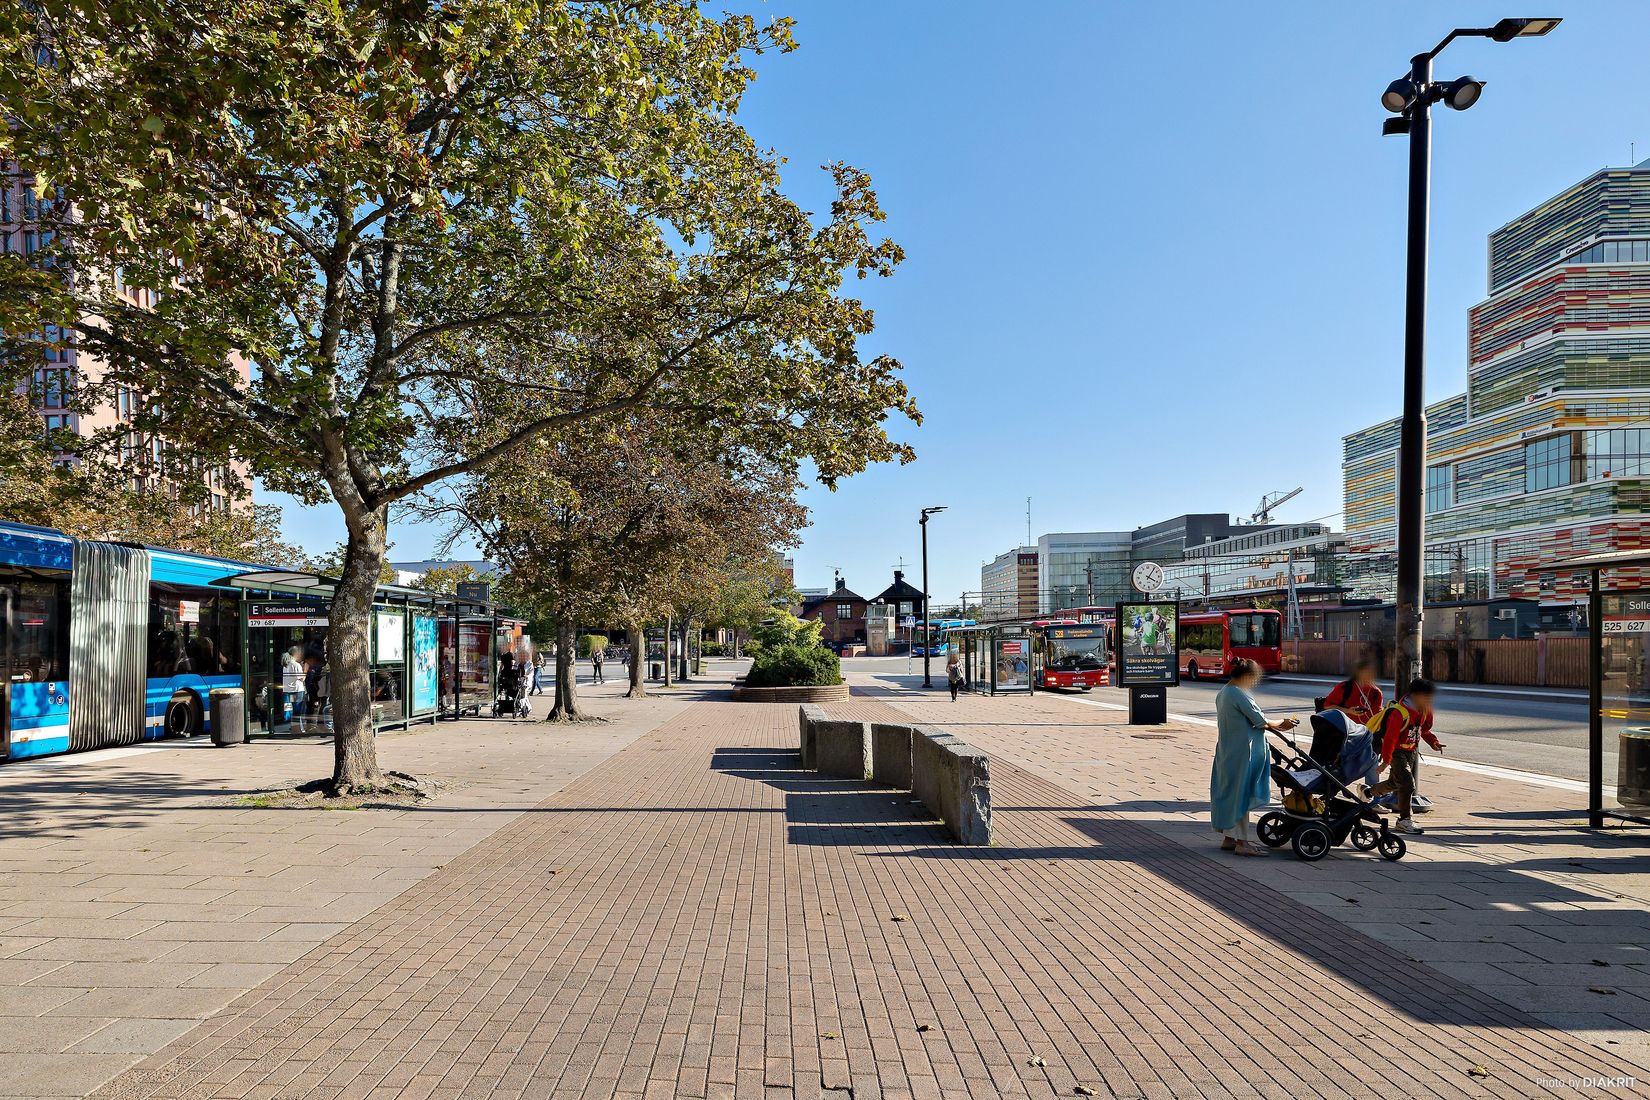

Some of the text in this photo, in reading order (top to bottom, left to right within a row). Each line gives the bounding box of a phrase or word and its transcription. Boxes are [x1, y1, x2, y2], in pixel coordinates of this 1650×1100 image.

[252, 605, 259, 615] E
[1604, 622, 1645, 631] 525 627
